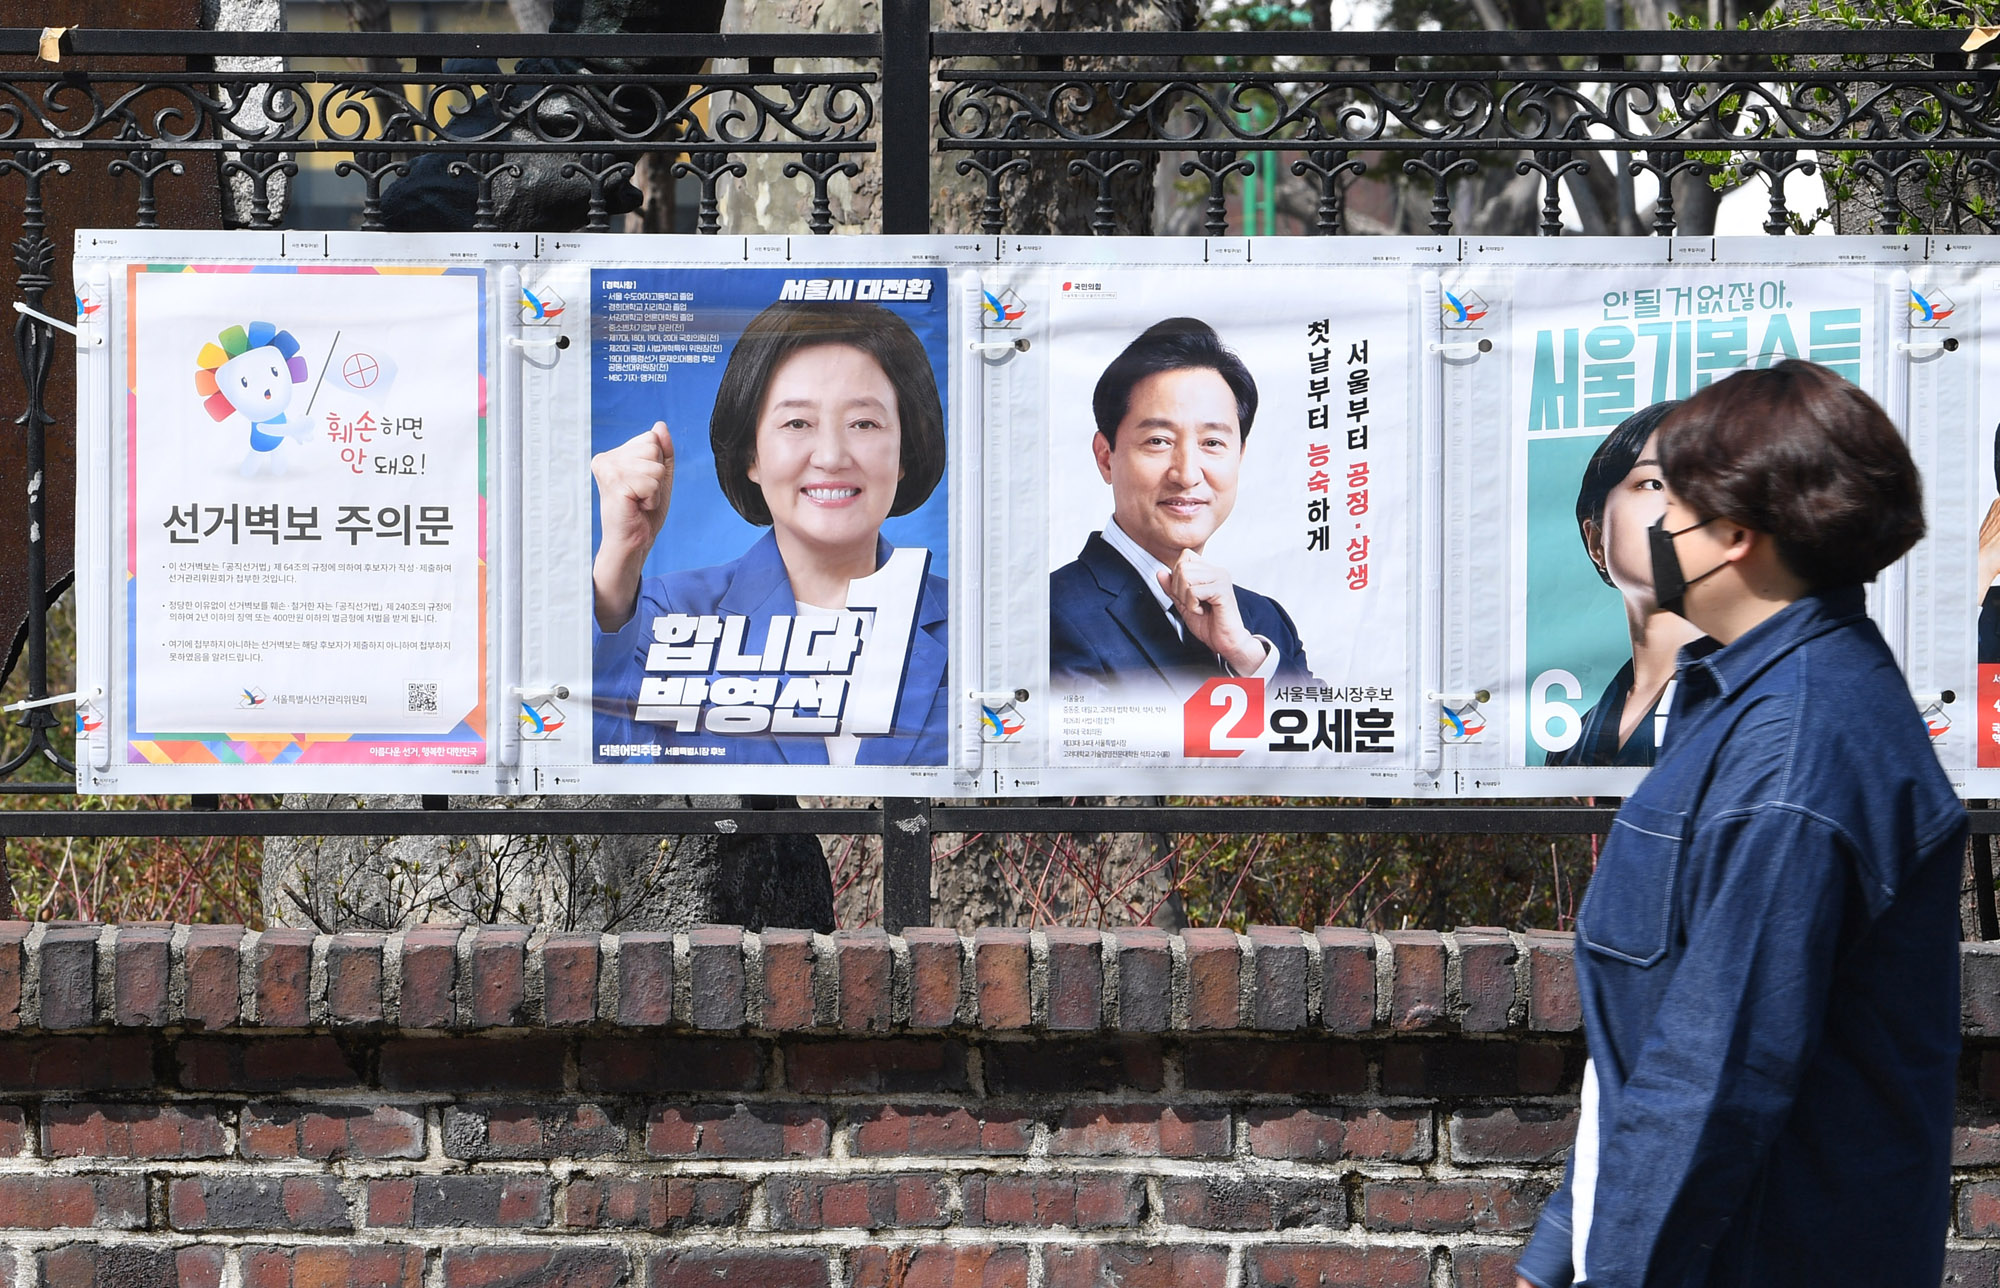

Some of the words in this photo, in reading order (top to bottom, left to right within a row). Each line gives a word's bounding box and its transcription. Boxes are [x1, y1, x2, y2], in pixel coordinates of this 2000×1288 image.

[778, 278, 854, 301] 서울시
[855, 278, 932, 301] 대전환
[609, 314, 643, 322] 서강대학교
[644, 314, 679, 322] 언론대학원
[680, 314, 694, 322] 졸업
[665, 334, 678, 342] 20대
[680, 334, 720, 342] 국회의원(전)
[609, 374, 623, 382] MBC
[1308, 319, 1331, 429] 첫날부터
[1347, 340, 1370, 449] 서울부터
[341, 449, 366, 473] 안
[375, 454, 425, 475] 돼요!
[1307, 444, 1330, 551] 능숙하게
[163, 503, 321, 545] 선거벽보
[335, 505, 453, 545] 주의문
[169, 562, 177, 571] 이
[178, 562, 220, 572] 선거벽보는
[222, 562, 271, 572] 「공직선거법」
[274, 563, 282, 572] 제
[283, 563, 310, 572] 64조의
[311, 563, 336, 572] 규정에
[338, 564, 362, 572] 의하여
[364, 564, 397, 572] 후보자가
[169, 574, 233, 583] 선거관리위원회가
[237, 575, 259, 583] 첩부한
[263, 575, 296, 583] 것입니다.
[169, 600, 193, 611] 정당한
[195, 601, 227, 611] 이유없이
[228, 601, 268, 611] 선거벽보를
[317, 602, 333, 611] 자는
[336, 602, 383, 612] 「공직선거법」
[386, 603, 394, 611] 제
[396, 603, 426, 612] 240조의
[428, 603, 452, 612] 규정에
[170, 613, 193, 621] 의하여
[211, 613, 234, 621] 이하의
[237, 613, 252, 622] 징역
[255, 614, 270, 622] 또는
[273, 614, 303, 622] 400만원
[306, 614, 329, 622] 이하의
[332, 614, 364, 622] 벌금형에
[367, 614, 390, 622] 처벌을
[393, 614, 408, 623] 받게
[411, 614, 437, 623] 됩니다.
[169, 640, 193, 649] 여기에
[195, 640, 226, 649] 첩부하지
[228, 640, 259, 650] 아니하는
[262, 641, 301, 650] 선거벽보는
[302, 641, 318, 650] 해당
[320, 641, 352, 650] 후보자가
[353, 641, 385, 650] 제출하지
[386, 642, 418, 651] 아니하여
[420, 642, 451, 651] 첩부하지
[644, 612, 863, 675] 합니다
[845, 548, 932, 737] 1
[170, 653, 209, 661] 못하였음을
[212, 653, 263, 662] 알려드립니다.
[273, 695, 367, 704] 서울특별시선거관리위원회
[634, 674, 850, 736] 박영선
[1530, 668, 1583, 753] 6
[1208, 683, 1249, 751] 2
[1269, 708, 1394, 752] 오세훈
[1095, 739, 1126, 747] 서울특별시장
[370, 747, 401, 756] 아름다운
[403, 748, 420, 756] 선거,
[422, 747, 445, 757] 행복한
[447, 747, 477, 756] 대한민국
[600, 745, 661, 756] 더불어민주당
[665, 747, 709, 755] 서울특별시장
[1063, 750, 1090, 758] 고려대학교
